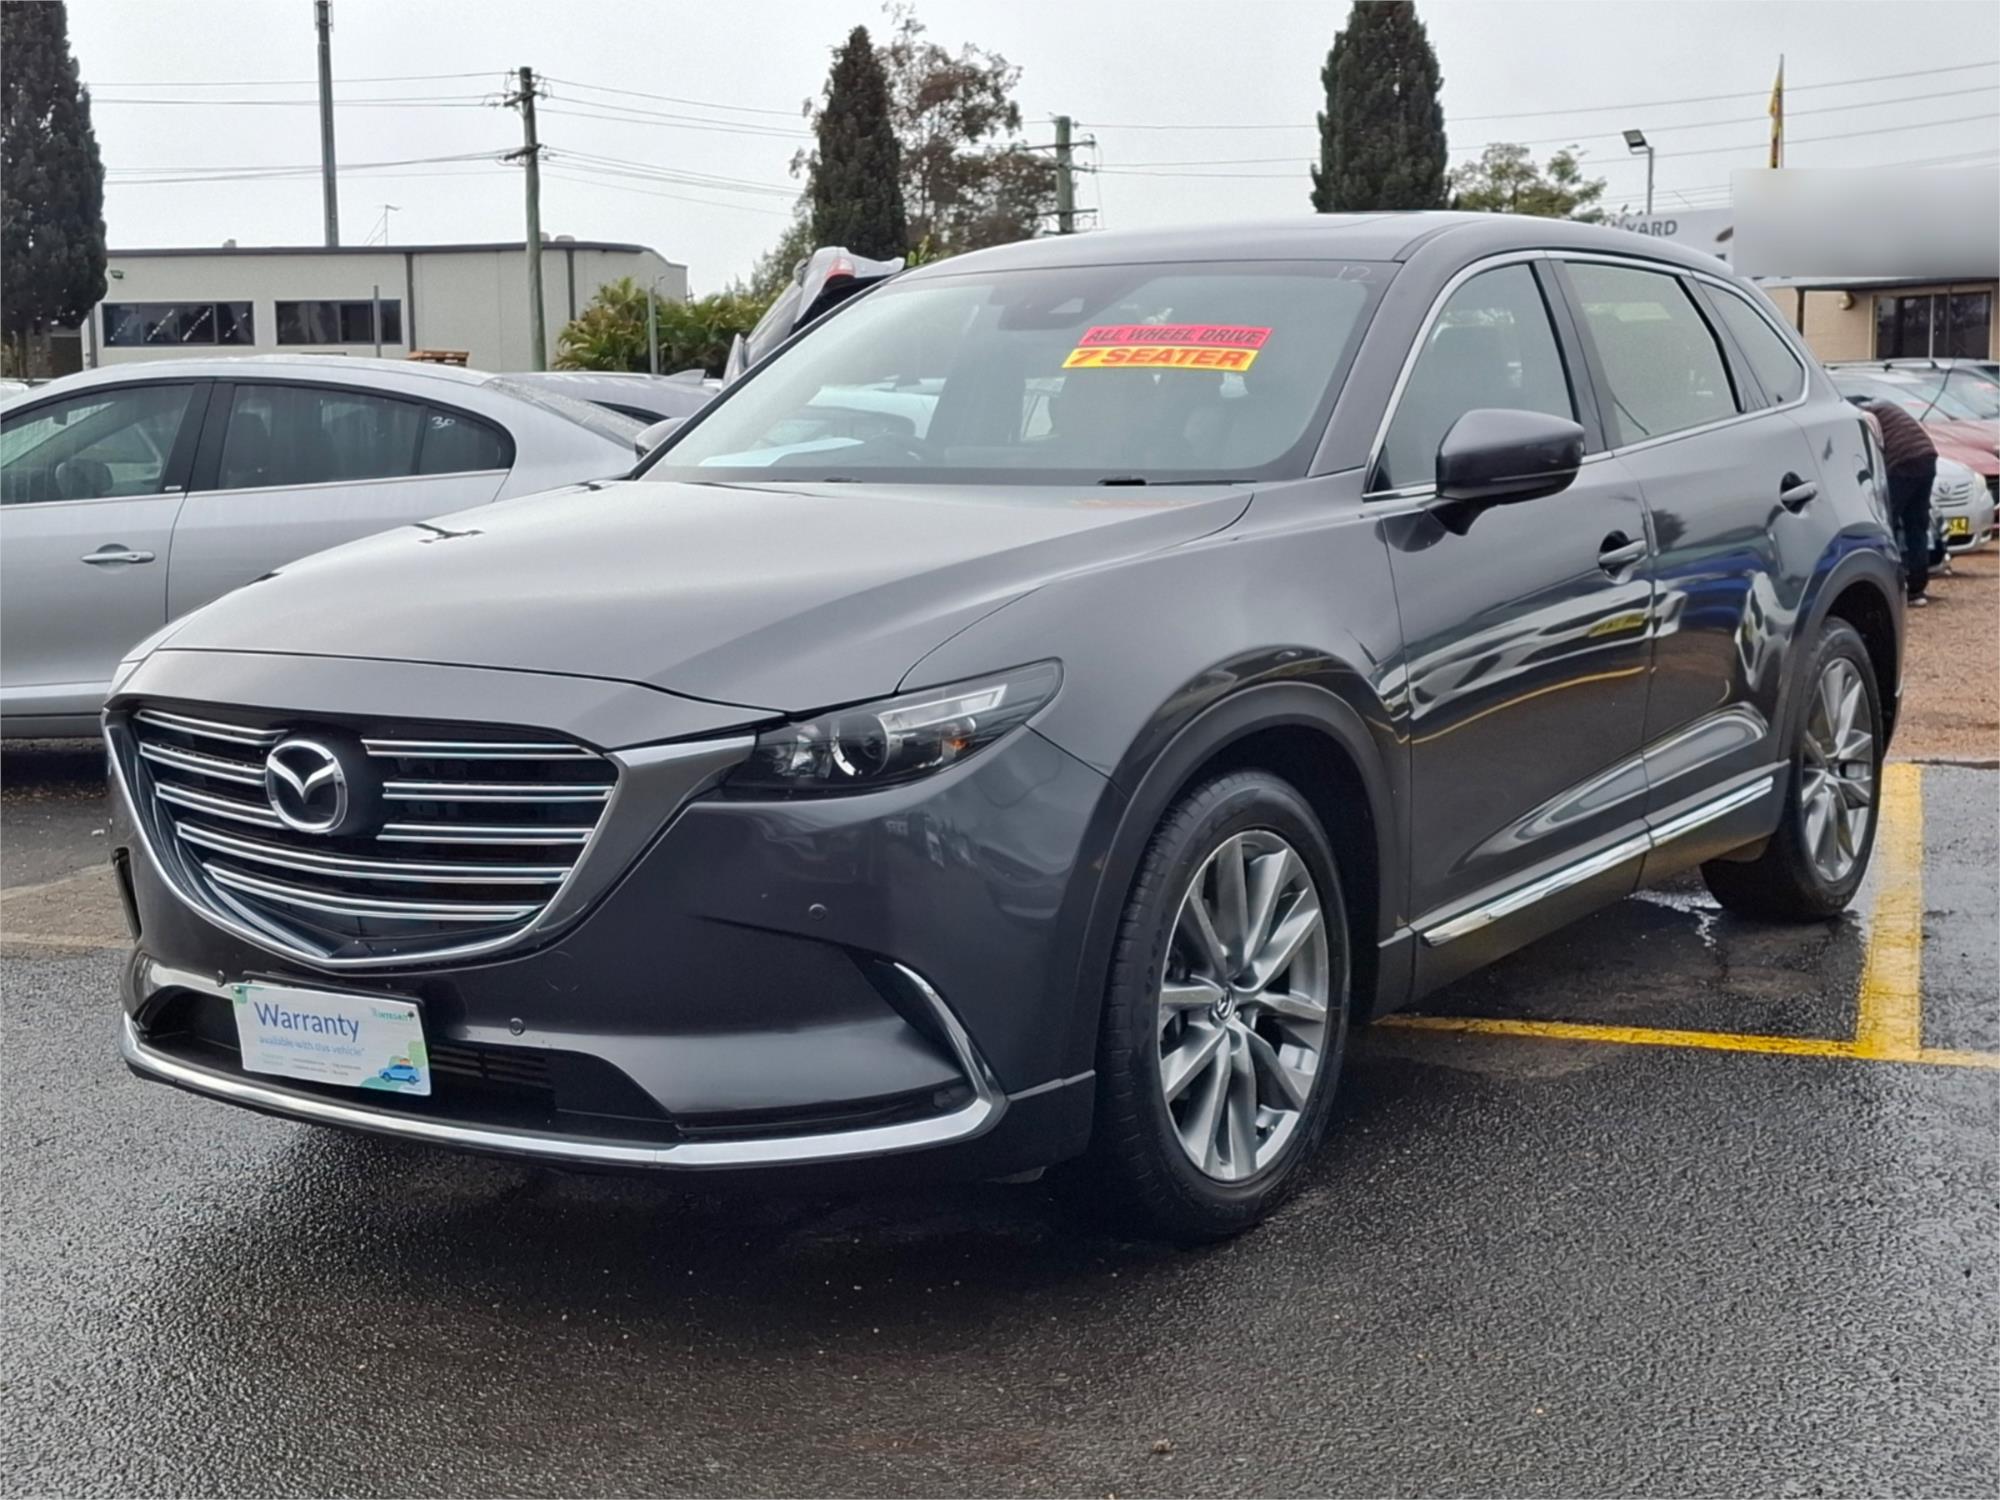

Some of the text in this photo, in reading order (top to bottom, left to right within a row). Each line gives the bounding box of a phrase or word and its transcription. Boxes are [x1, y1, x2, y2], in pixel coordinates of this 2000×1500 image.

[1086, 328, 1266, 344] ALL WHEEL DRIVE
[1071, 349, 1248, 367] 7 SEATER
[254, 1001, 360, 1043] Warranty
